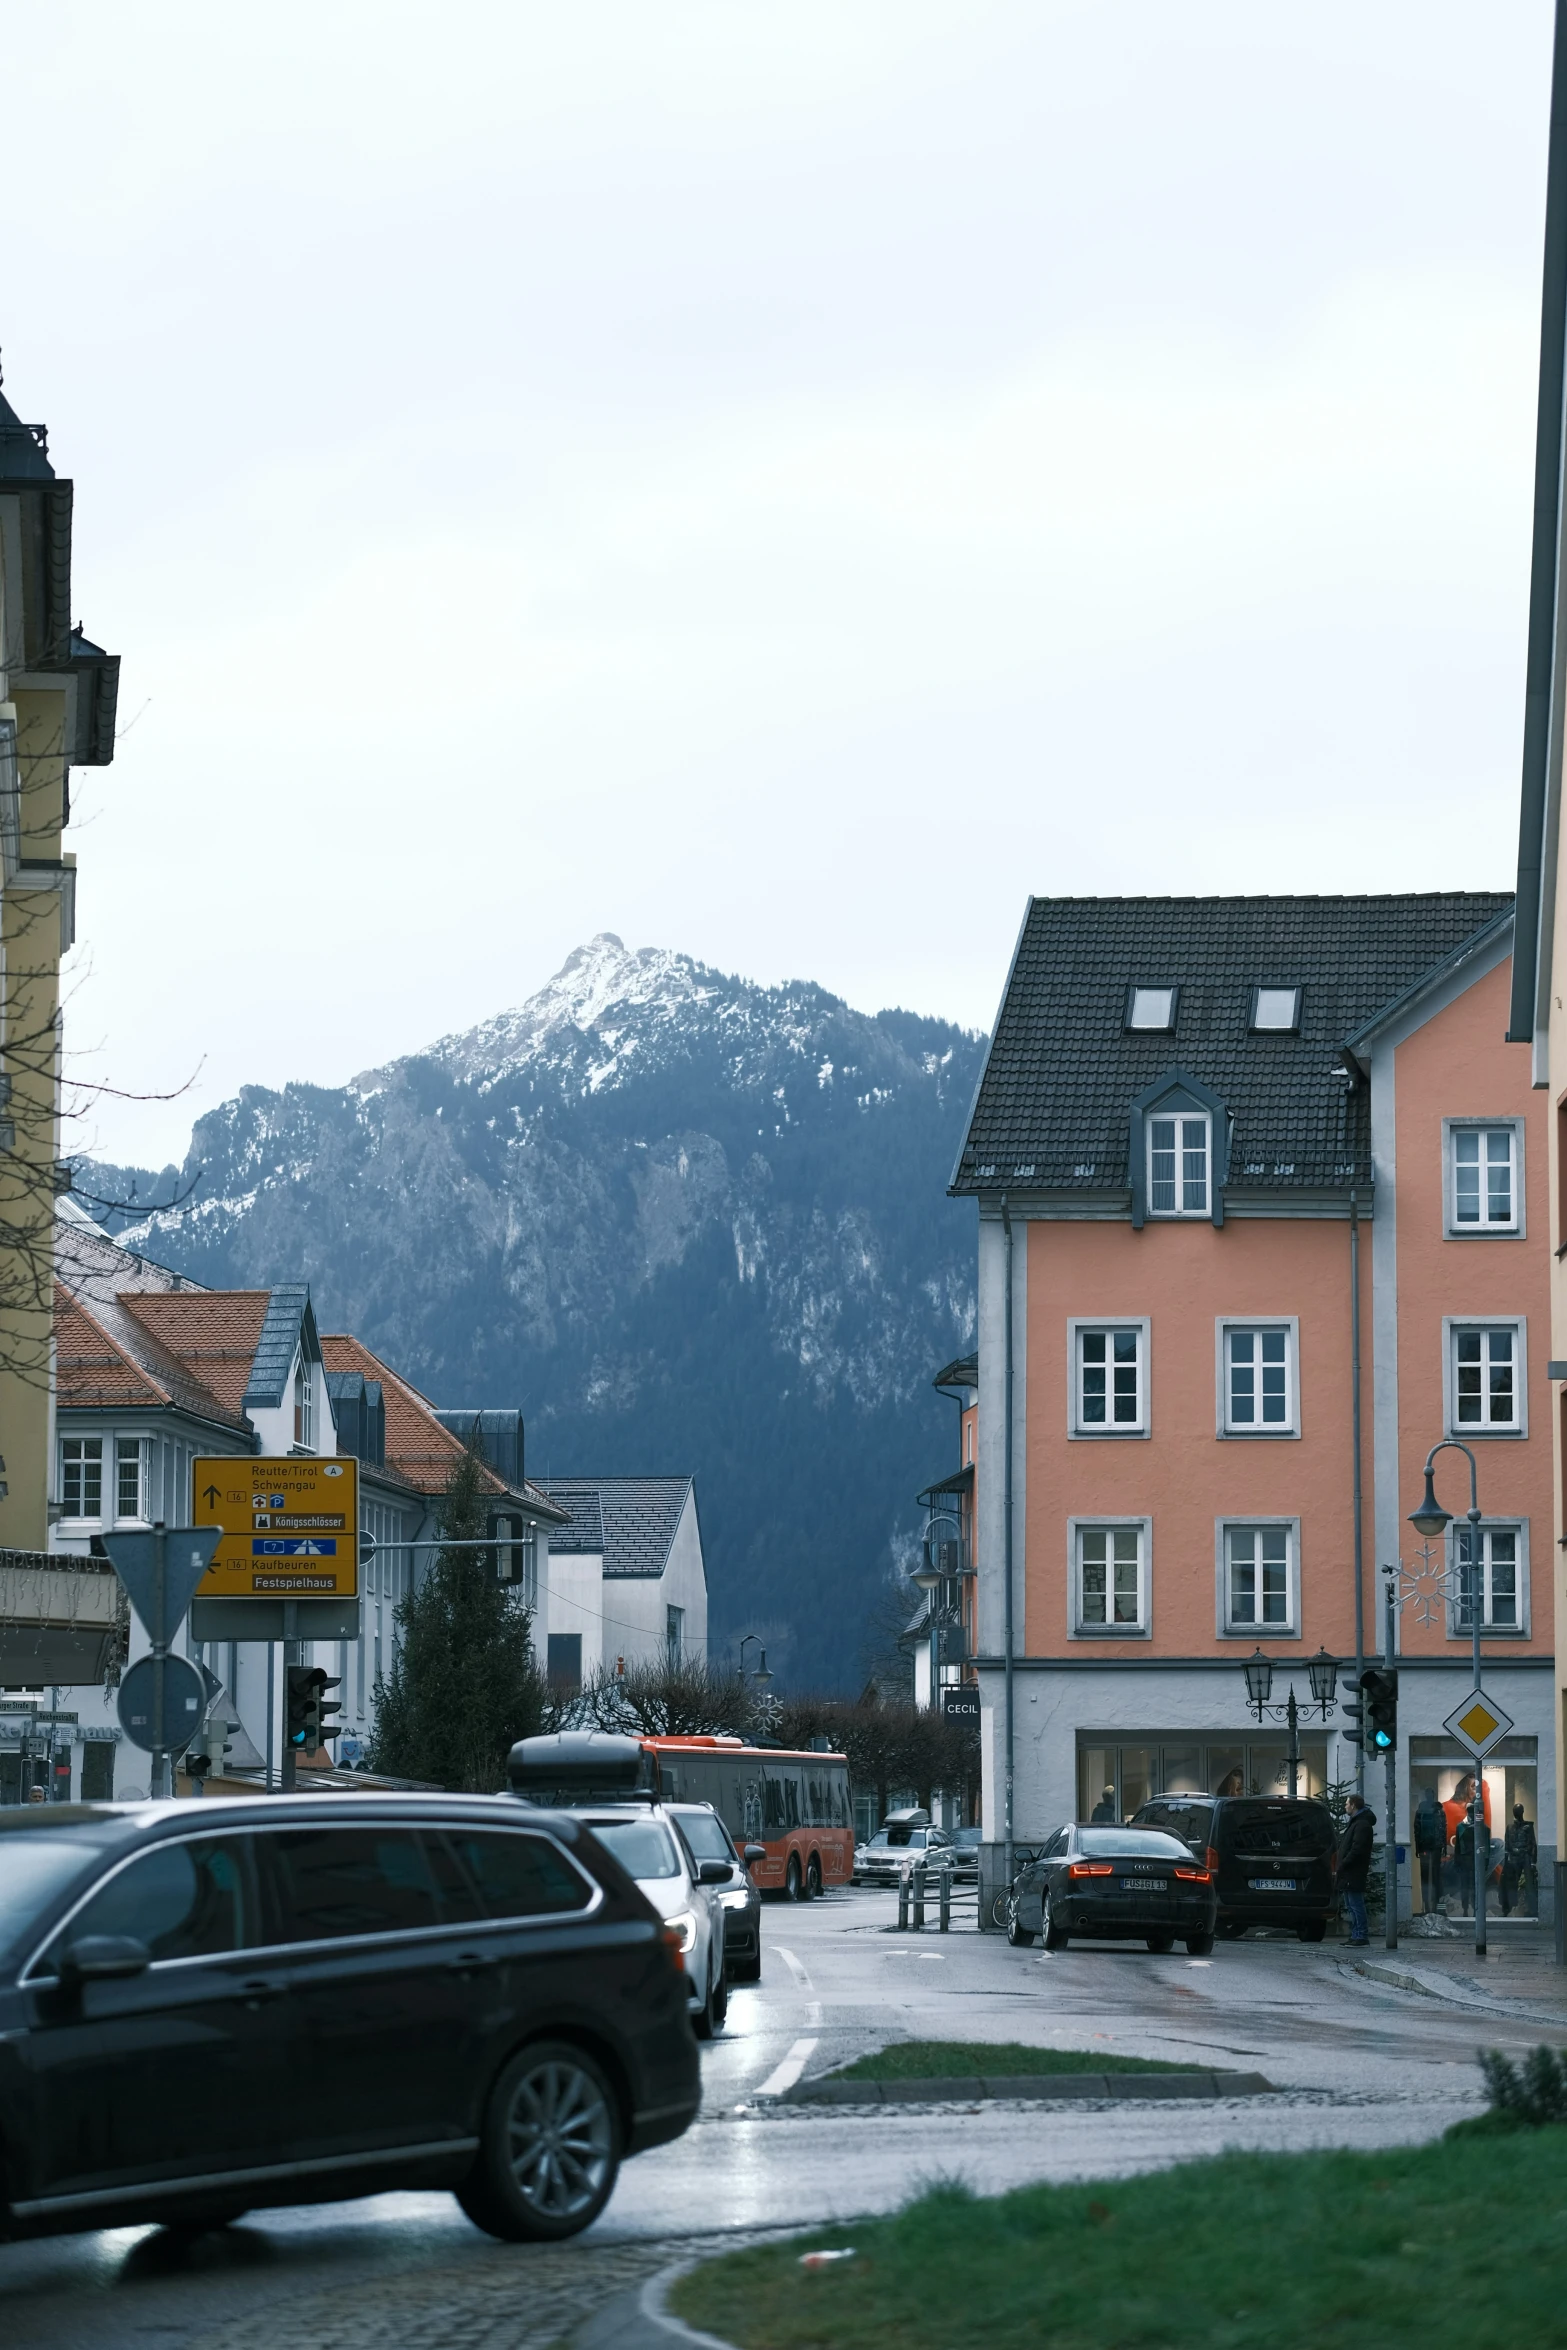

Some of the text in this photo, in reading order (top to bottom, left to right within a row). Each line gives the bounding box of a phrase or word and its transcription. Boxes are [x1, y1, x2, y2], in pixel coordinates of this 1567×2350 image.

[252, 1466, 318, 1476] Reutte/Tirol
[252, 1480, 316, 1492] Schwangau
[232, 1493, 241, 1501] 16
[274, 1499, 281, 1507] P
[275, 1516, 342, 1529] Königsschlösser
[271, 1543, 277, 1551] 7
[232, 1560, 317, 1570] 16 Kaufbeuren
[255, 1578, 334, 1590] Festspielhaus
[947, 1704, 979, 1714] CECIL
